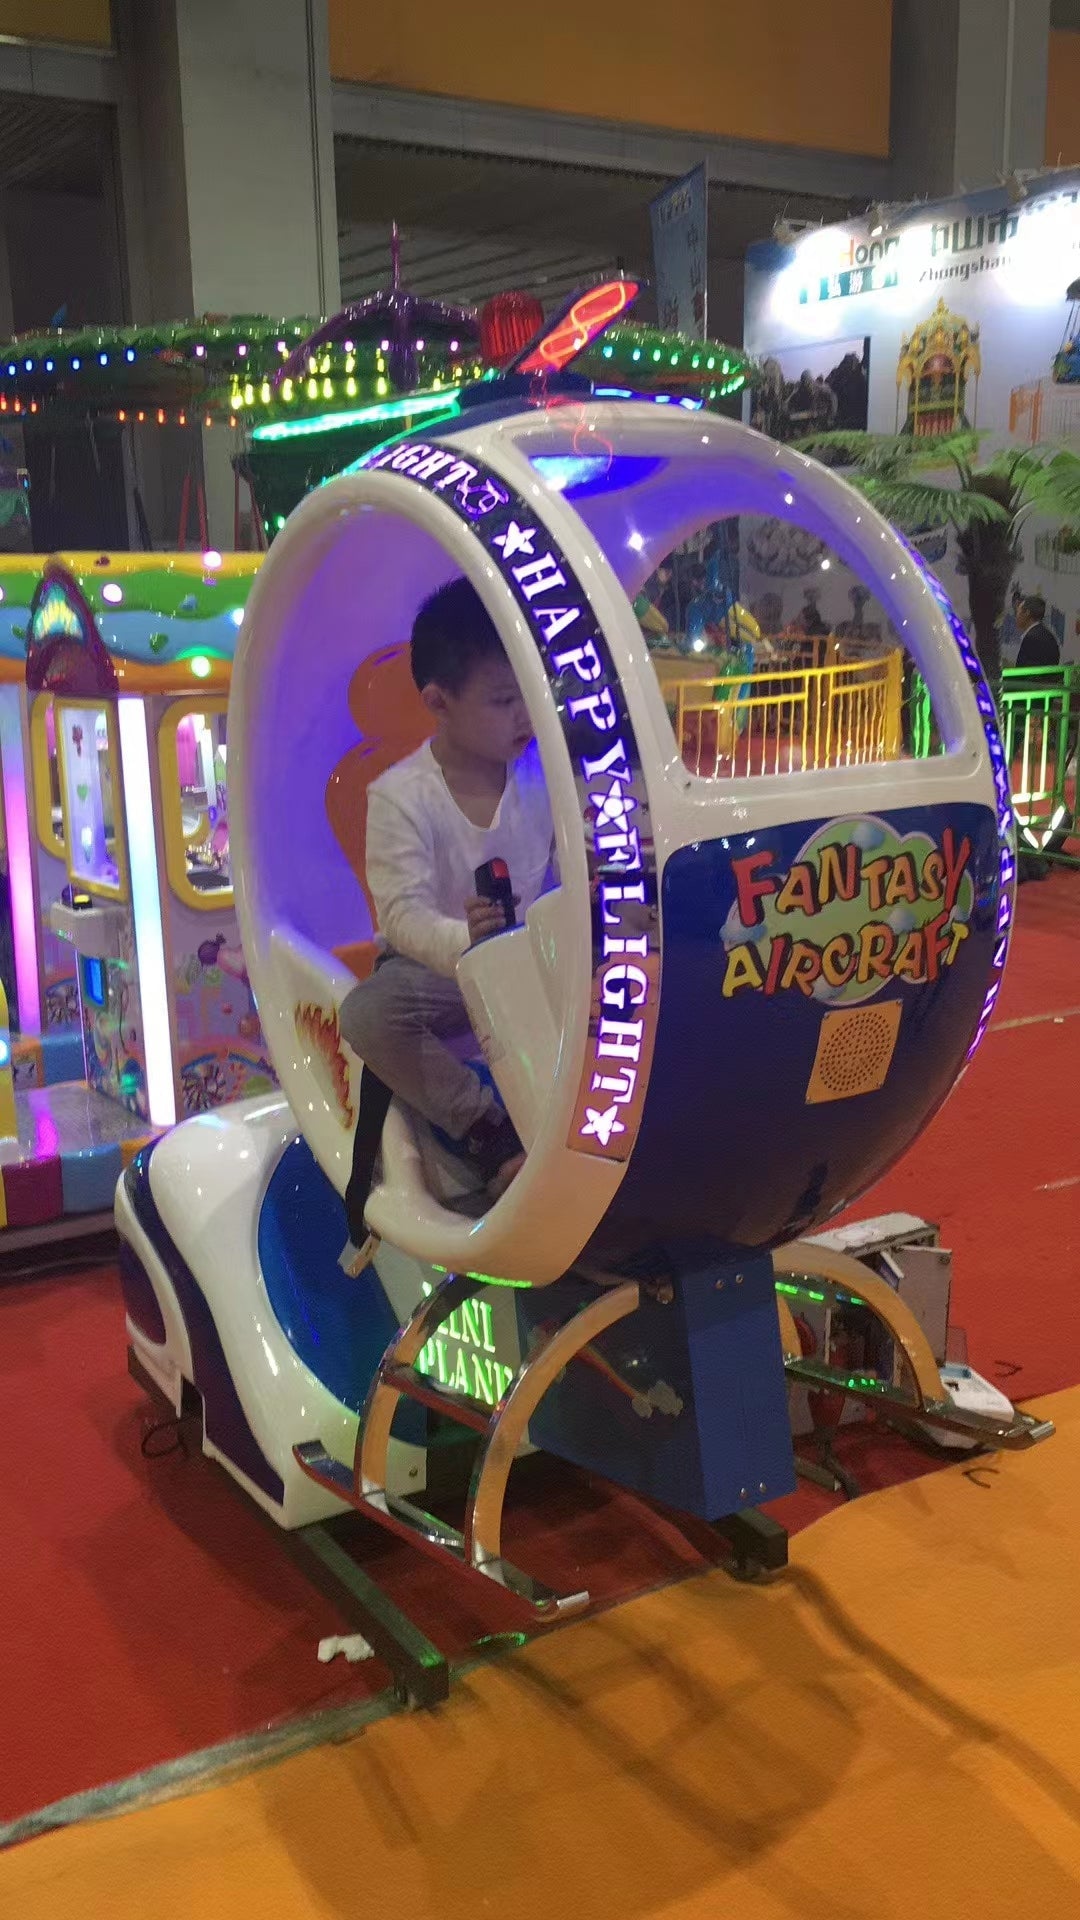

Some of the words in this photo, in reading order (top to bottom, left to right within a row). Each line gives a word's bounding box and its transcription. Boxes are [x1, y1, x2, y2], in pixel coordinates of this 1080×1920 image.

[512, 552, 632, 784] HAPPY
[592, 827, 648, 1104] FLIGHT
[731, 827, 971, 928] FANTASY
[721, 910, 969, 998] AIRCRAFT
[428, 1291, 496, 1353] INI
